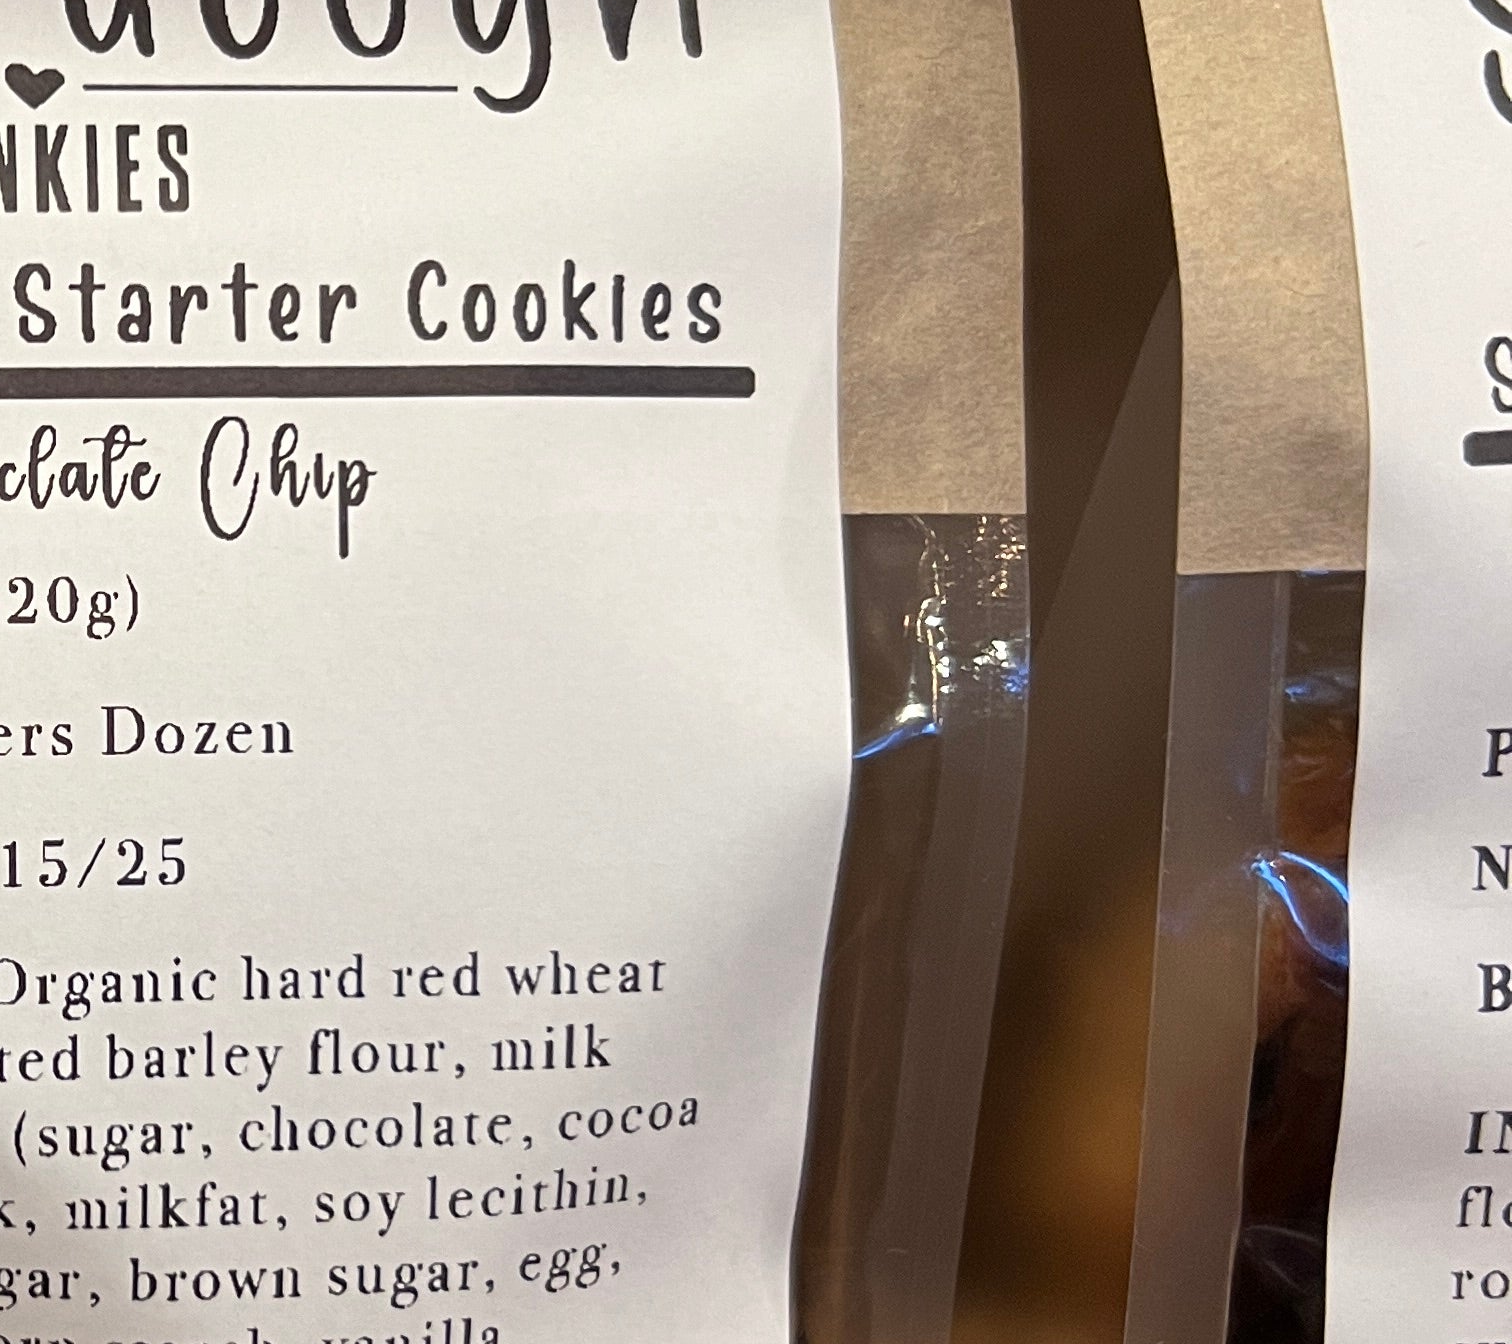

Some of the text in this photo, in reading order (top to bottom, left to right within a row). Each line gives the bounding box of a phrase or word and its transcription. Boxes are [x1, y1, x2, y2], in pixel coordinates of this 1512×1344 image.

[12, 261, 358, 345] Starter
[407, 258, 722, 344] Cookies
[199, 415, 378, 560] Chip
[100, 705, 294, 756] Dozen
[240, 952, 366, 1002] hard
[392, 950, 481, 998] red
[505, 950, 666, 996] wheat
[105, 1029, 284, 1093] barley
[308, 1027, 466, 1080] flour,
[491, 1022, 611, 1072] milk
[13, 1110, 213, 1173] (sugar,
[239, 1101, 533, 1153] chocolate,
[558, 1097, 699, 1142] cocoa
[65, 1180, 288, 1232] milkfat,
[314, 1190, 405, 1238] soy
[427, 1165, 647, 1221] lecithin,
[129, 1256, 302, 1303] brown
[328, 1259, 495, 1311] sugar,
[518, 1242, 621, 1294] egg,
